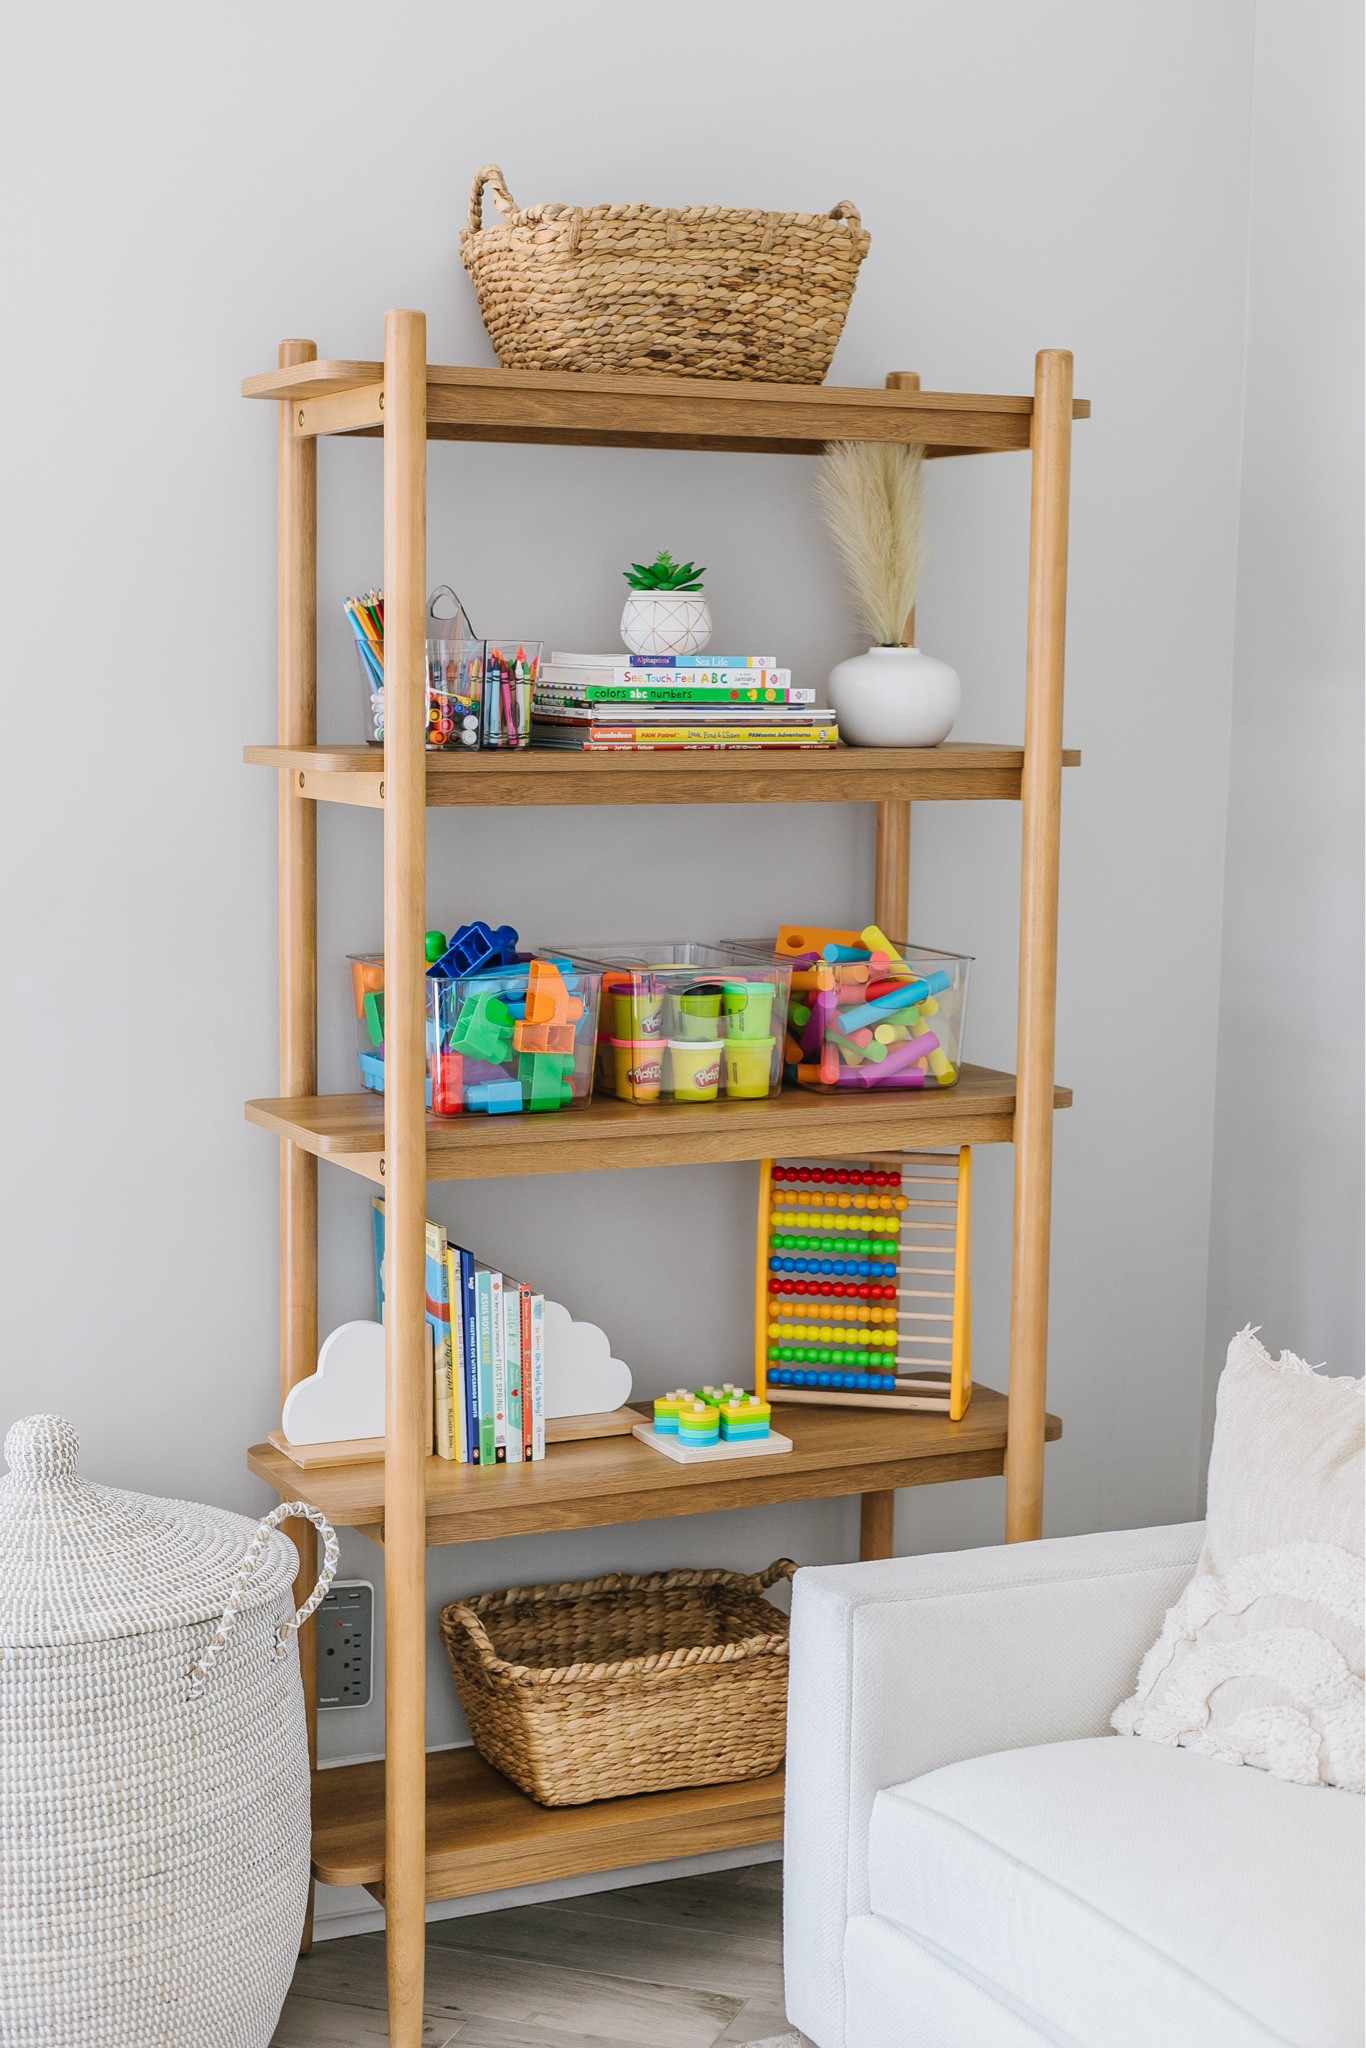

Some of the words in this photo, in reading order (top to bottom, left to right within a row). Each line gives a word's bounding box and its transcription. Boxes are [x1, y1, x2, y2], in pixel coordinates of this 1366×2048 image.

[636, 656, 670, 665] Alphaprints
[695, 657, 709, 667] Sea
[711, 656, 729, 667] Life
[675, 672, 696, 684] Feel
[701, 672, 728, 684] ABC
[594, 688, 627, 699] colors
[629, 688, 648, 699] abc
[650, 688, 693, 699] numbers
[593, 731, 633, 739] nickelodeon
[482, 1291, 490, 1315] JESUS
[482, 1315, 490, 1336] ROSE
[483, 1336, 491, 1351] FOR
[484, 1352, 492, 1365] ME
